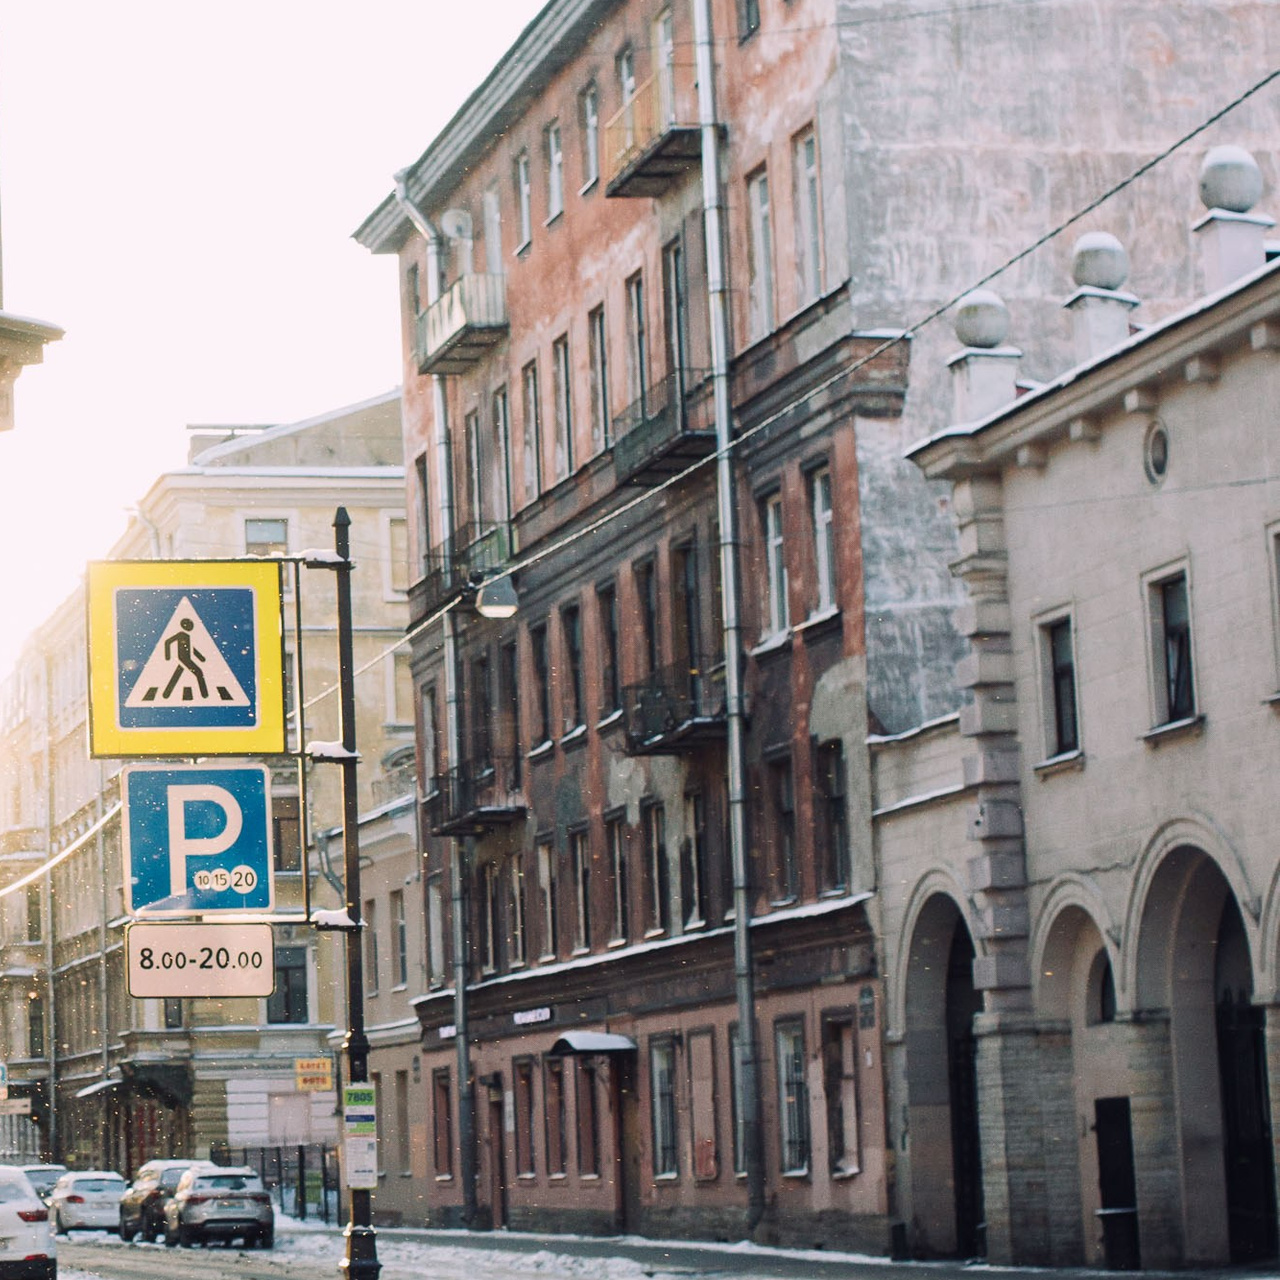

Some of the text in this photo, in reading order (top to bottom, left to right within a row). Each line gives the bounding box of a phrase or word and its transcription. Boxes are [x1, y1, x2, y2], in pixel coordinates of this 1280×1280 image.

[167, 784, 243, 896] P
[198, 871, 255, 887] 10 15 20
[139, 946, 263, 970] 8.00-20.00
[347, 1092, 372, 1103] 7805
